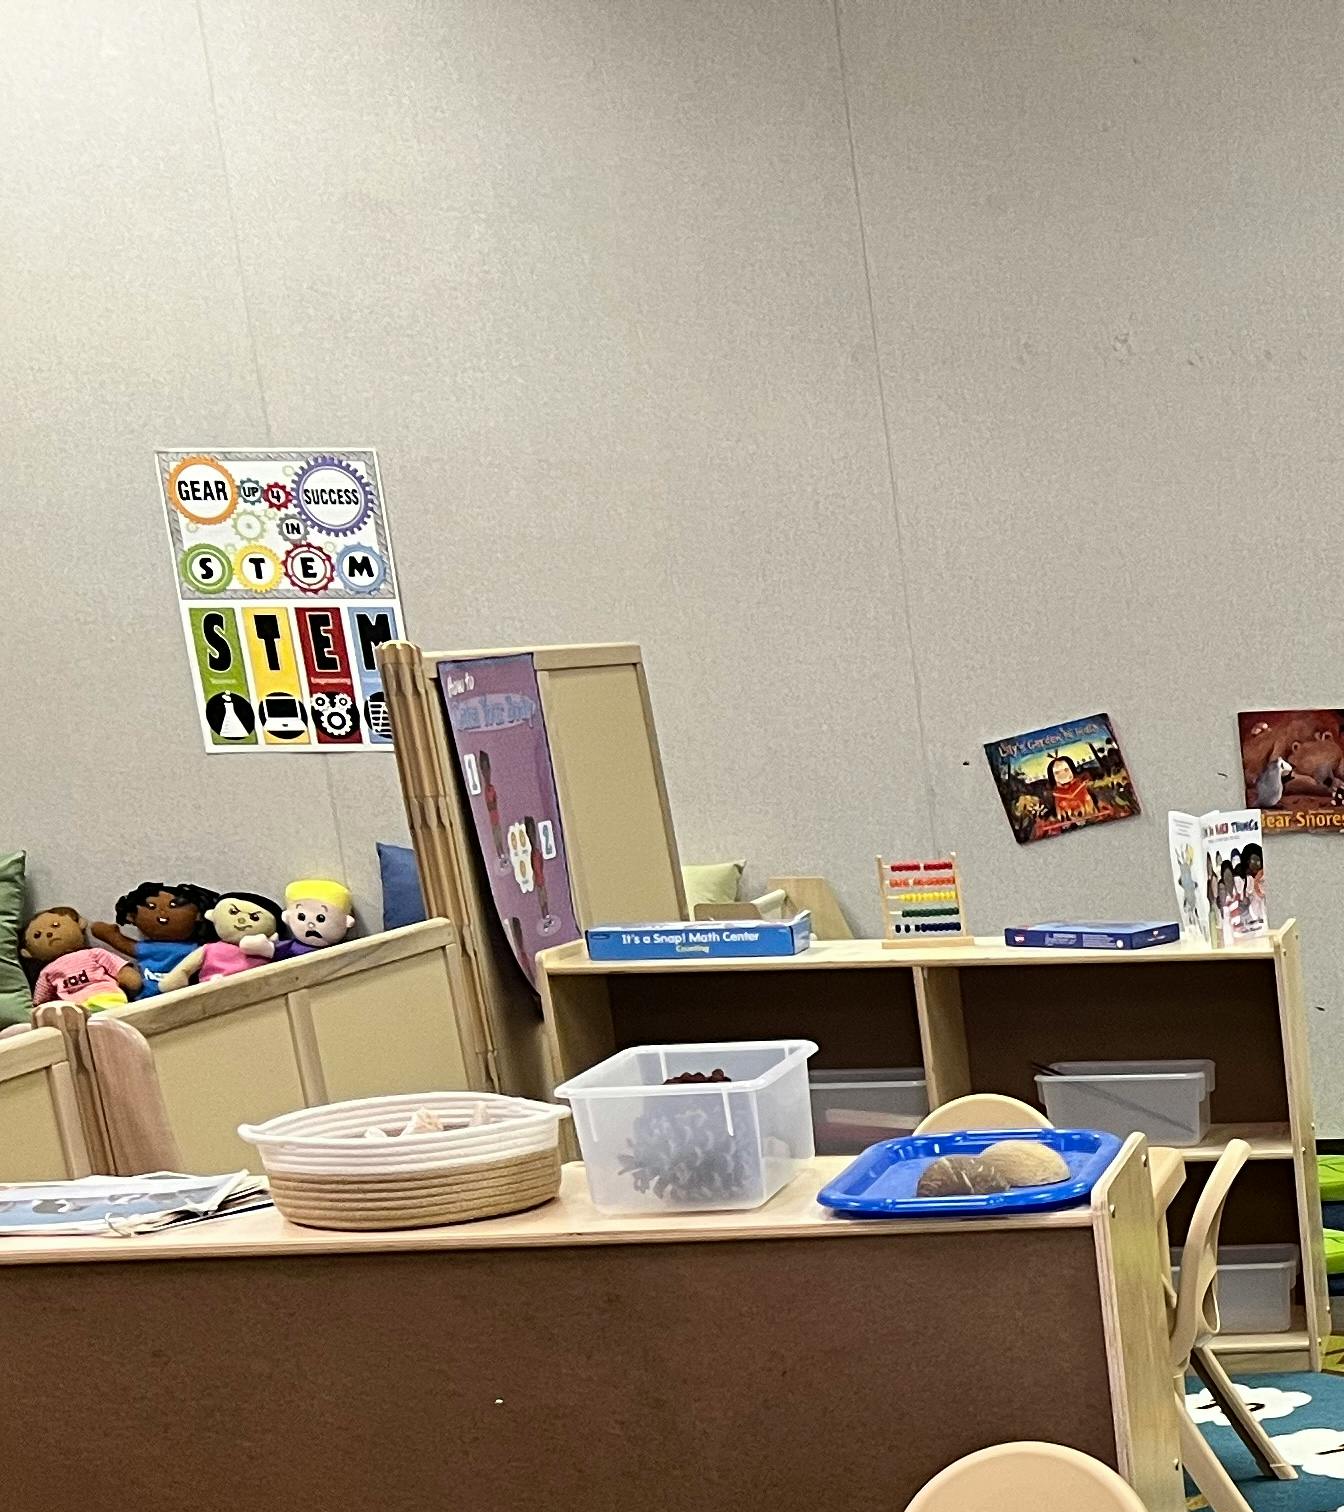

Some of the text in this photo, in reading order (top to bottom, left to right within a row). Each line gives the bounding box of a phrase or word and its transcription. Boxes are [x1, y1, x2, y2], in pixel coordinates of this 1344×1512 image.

[178, 480, 360, 505] GEAR UP 4 SUCCESS
[285, 522, 301, 535] IN
[622, 931, 759, 946] It's a Snap! Math Center
[63, 969, 90, 989] sad
